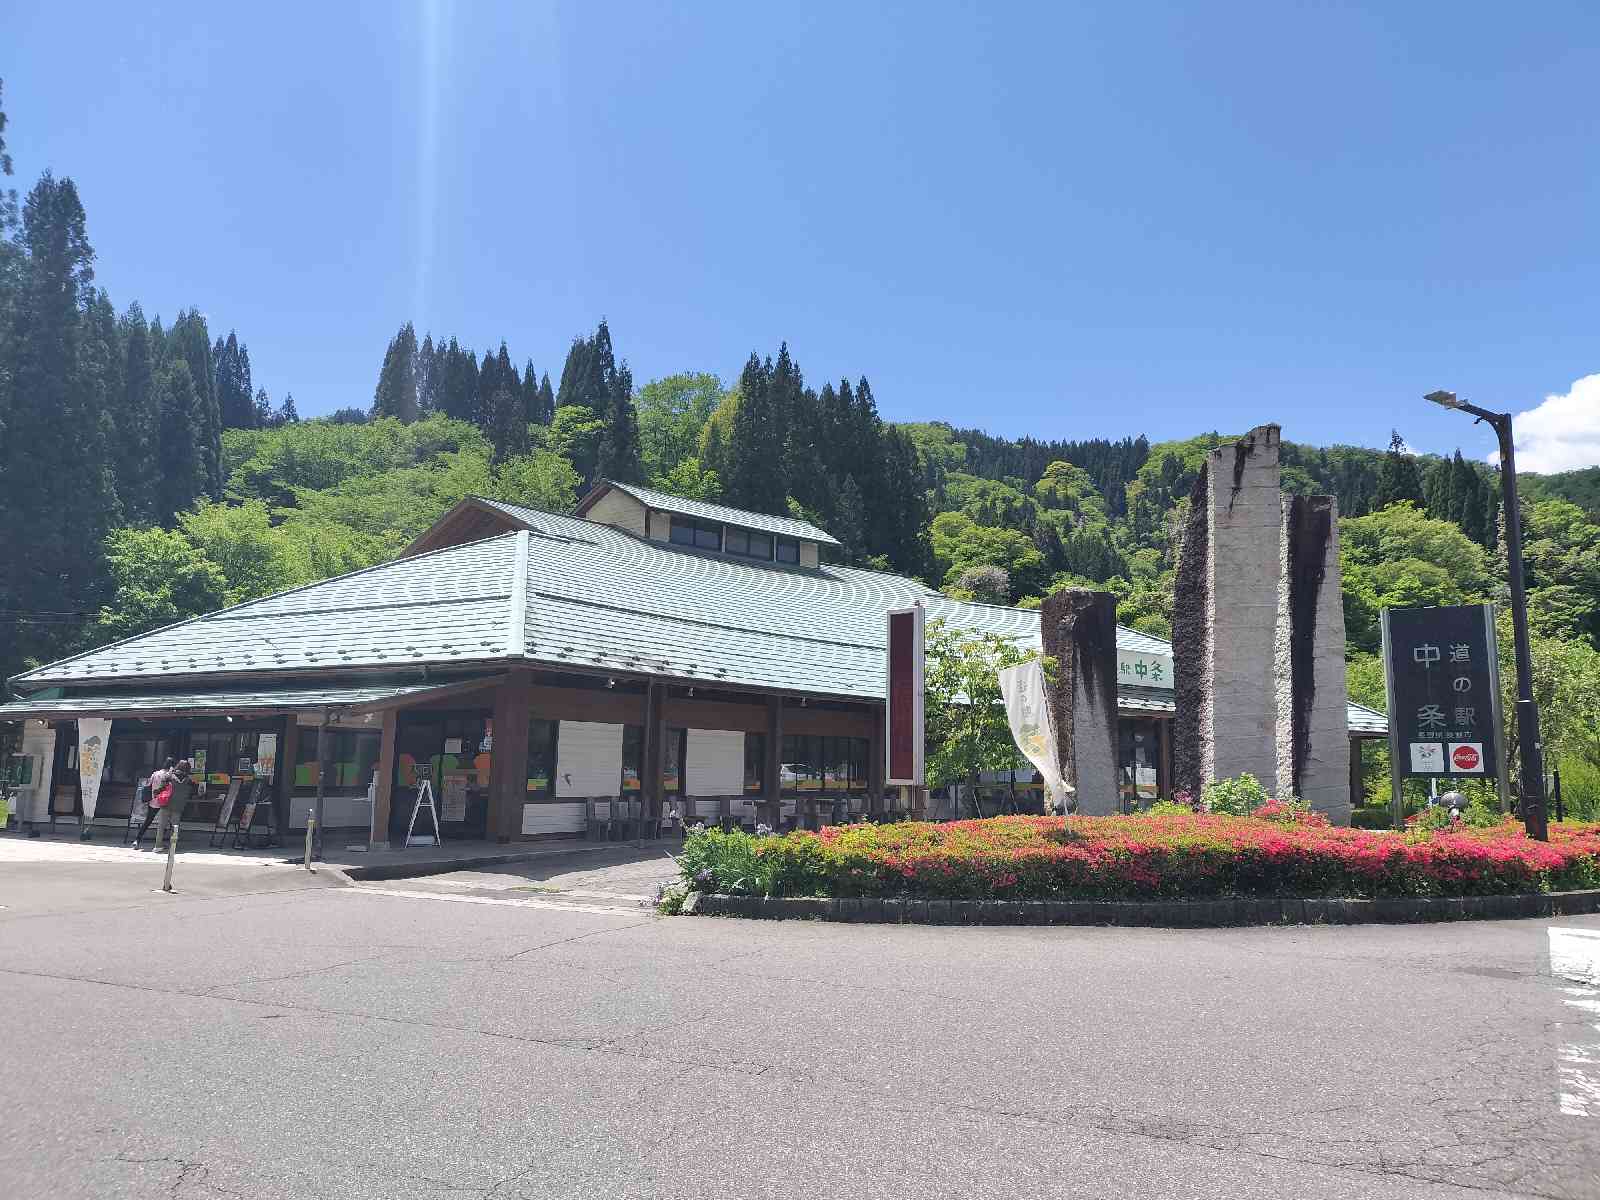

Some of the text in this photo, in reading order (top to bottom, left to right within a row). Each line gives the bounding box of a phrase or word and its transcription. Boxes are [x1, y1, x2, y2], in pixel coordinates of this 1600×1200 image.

[1413, 643, 1447, 728] 中条
[1449, 643, 1476, 726] 道の駅
